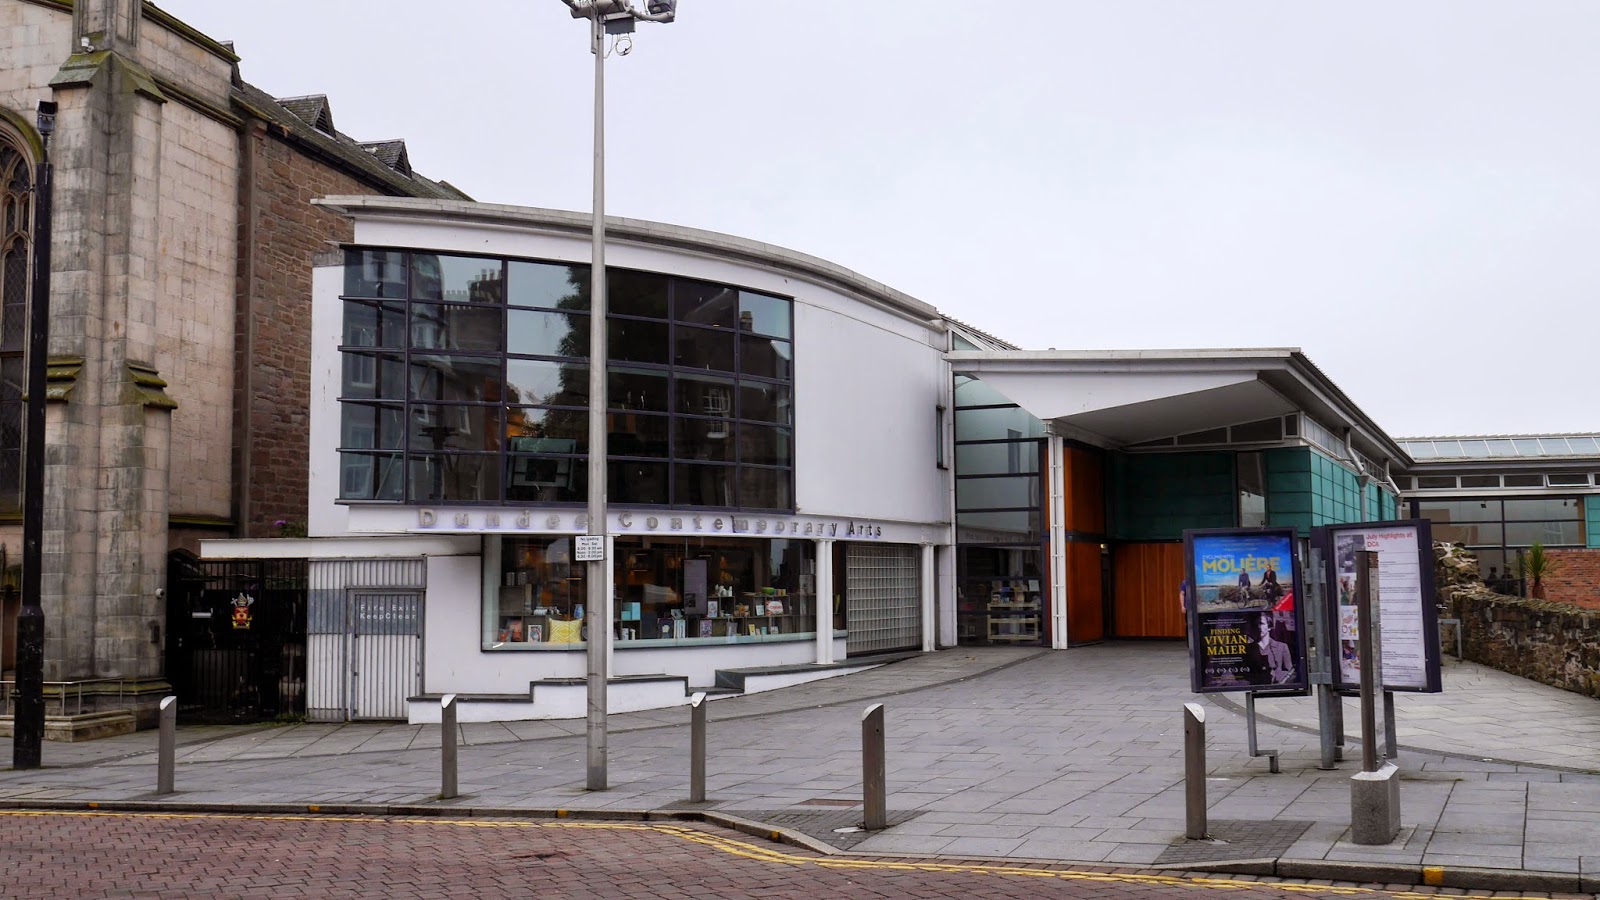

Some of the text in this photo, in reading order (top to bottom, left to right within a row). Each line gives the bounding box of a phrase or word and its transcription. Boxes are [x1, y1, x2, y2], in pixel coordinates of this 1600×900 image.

[419, 508, 882, 537] Dundee Contemporary Arts
[1366, 533, 1377, 541] July
[1379, 532, 1405, 541] Highlights
[1203, 554, 1280, 573] MOLIÈRE
[1204, 635, 1248, 645] VIVIAN
[1206, 645, 1247, 656] MAIER
